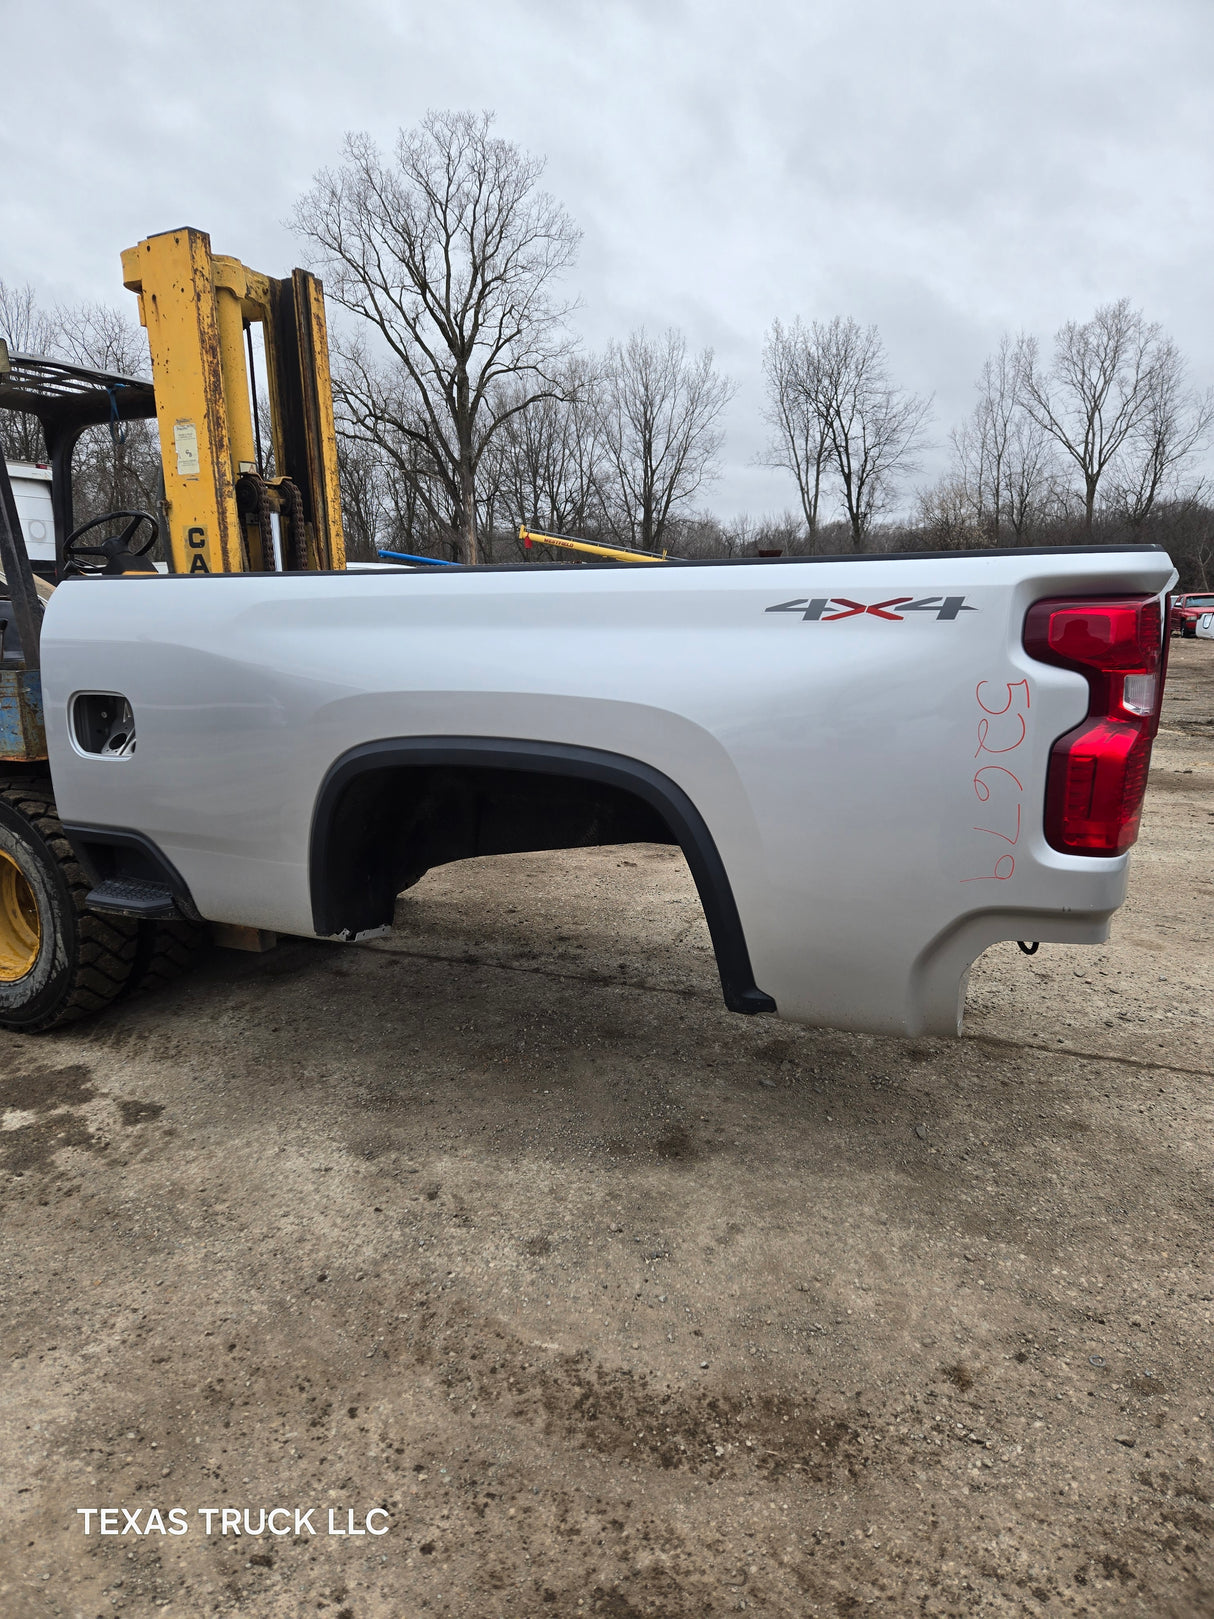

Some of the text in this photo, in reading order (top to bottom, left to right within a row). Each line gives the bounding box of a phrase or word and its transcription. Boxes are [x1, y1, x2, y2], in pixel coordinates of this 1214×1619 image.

[543, 538, 574, 548] WESTFIELD
[764, 596, 979, 621] 4X4
[959, 678, 1031, 883] 52679
